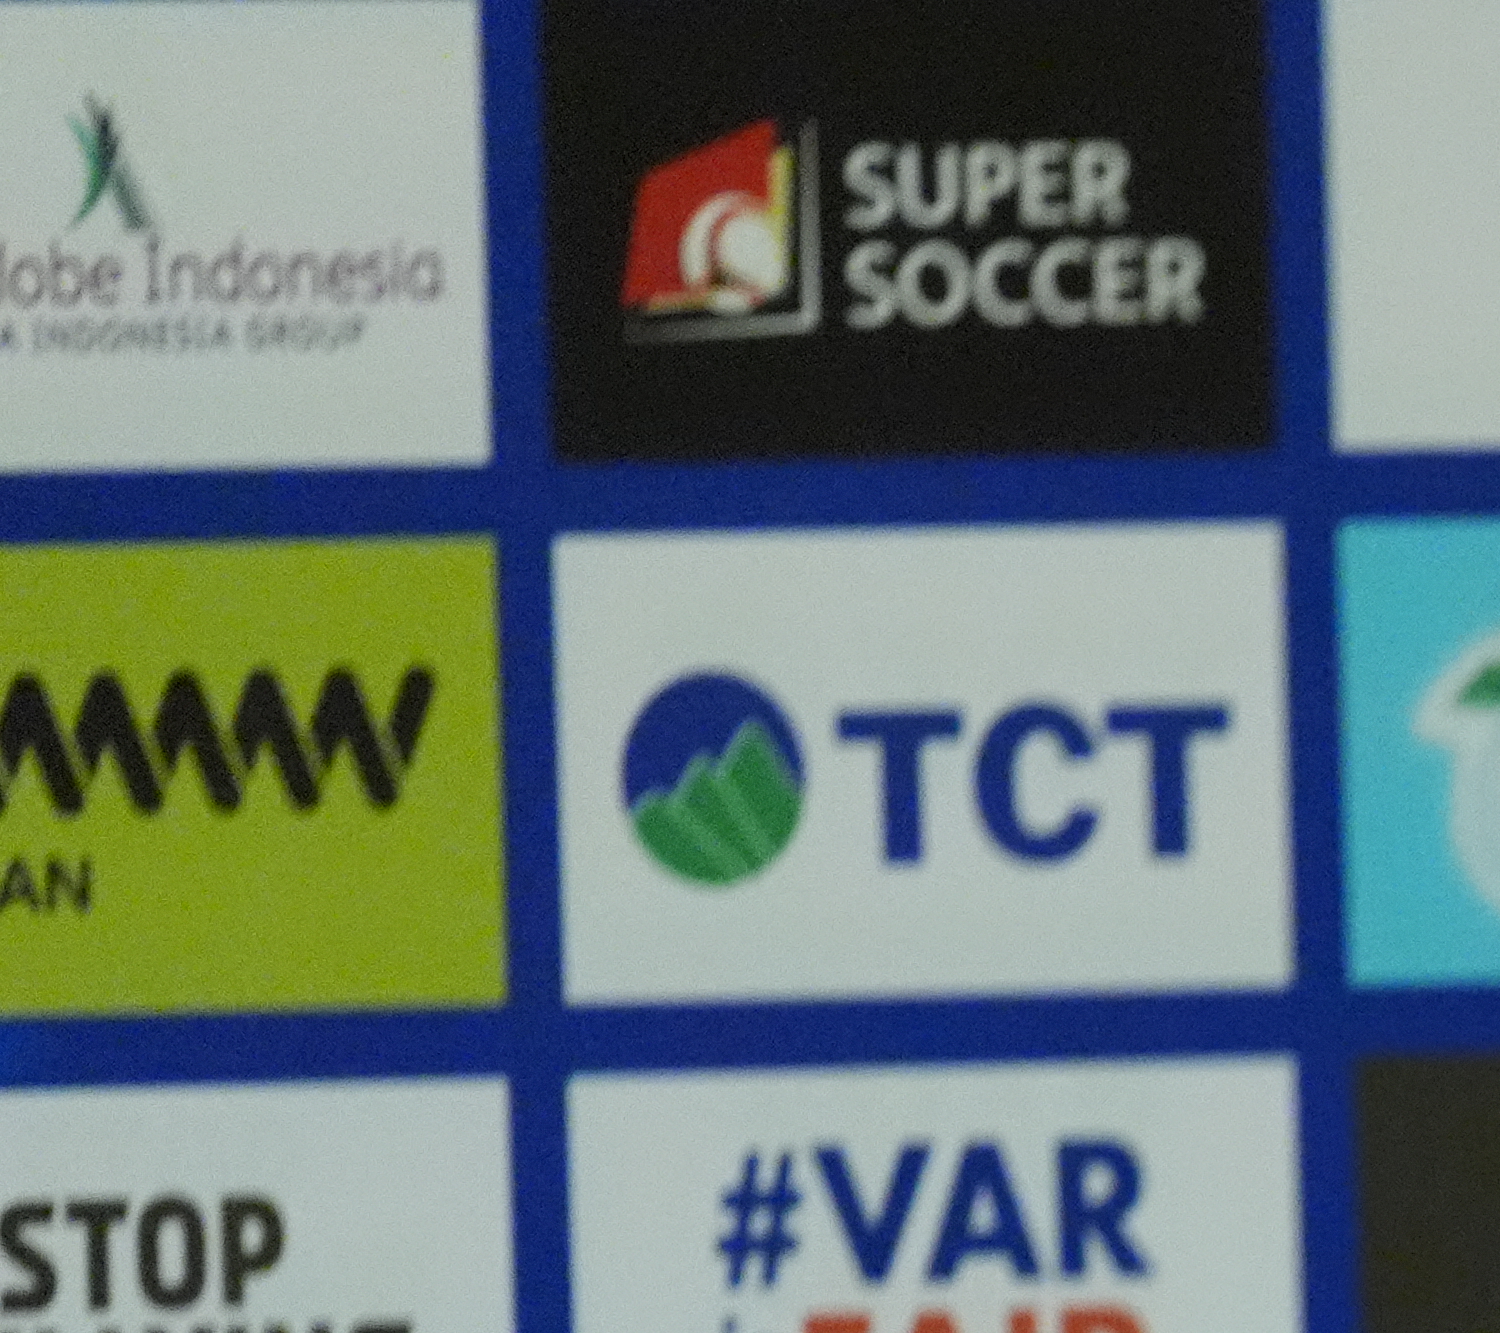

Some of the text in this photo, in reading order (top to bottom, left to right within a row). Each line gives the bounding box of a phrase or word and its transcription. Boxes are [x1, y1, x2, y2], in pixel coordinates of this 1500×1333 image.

[843, 140, 1130, 230] SUPER
[143, 232, 446, 306] Indonesia
[844, 237, 1205, 329] SOCCER
[834, 700, 1232, 866] TCT
[0, 855, 94, 914] AN
[0, 1195, 285, 1312] STOP
[715, 1137, 1149, 1288] #VAR
